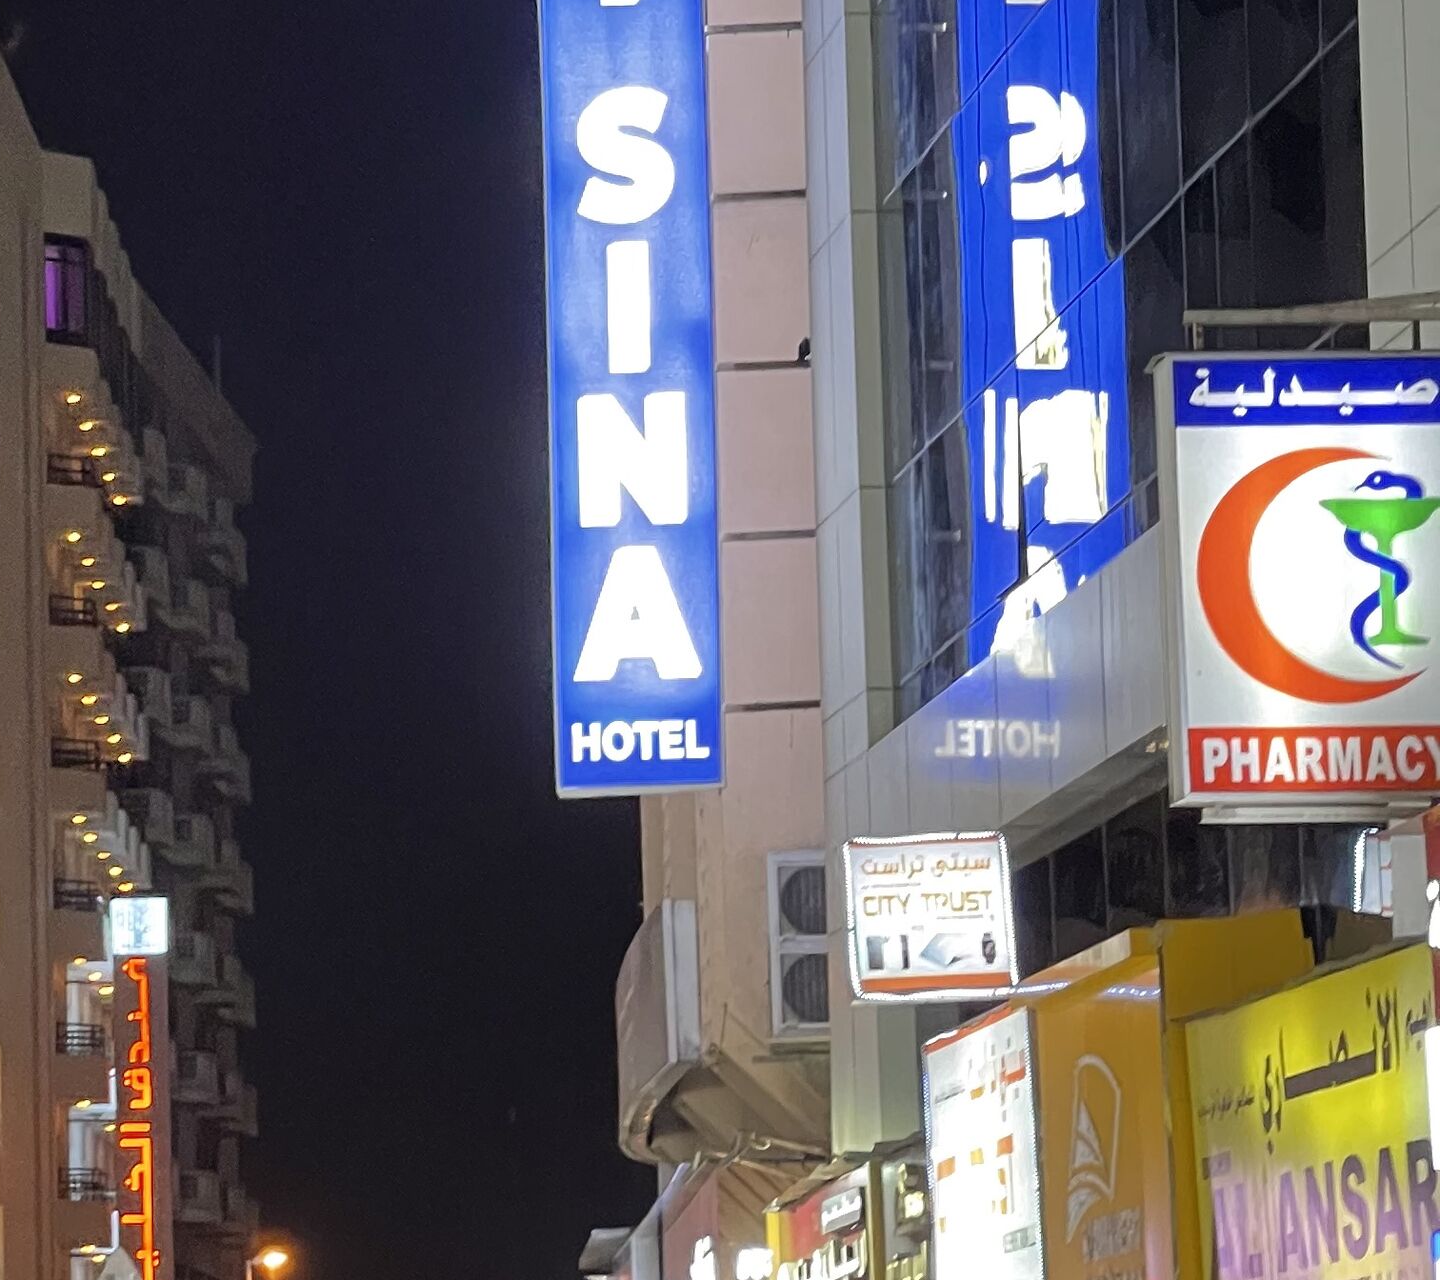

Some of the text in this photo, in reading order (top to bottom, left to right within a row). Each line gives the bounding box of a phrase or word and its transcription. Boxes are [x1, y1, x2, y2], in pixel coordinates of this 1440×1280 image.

[572, 85, 703, 683] SINA
[1188, 365, 1440, 417] صيدلية
[570, 719, 711, 764] HOTEL
[1202, 735, 1440, 784] PHARMACY
[863, 890, 993, 917] CITY TRUST
